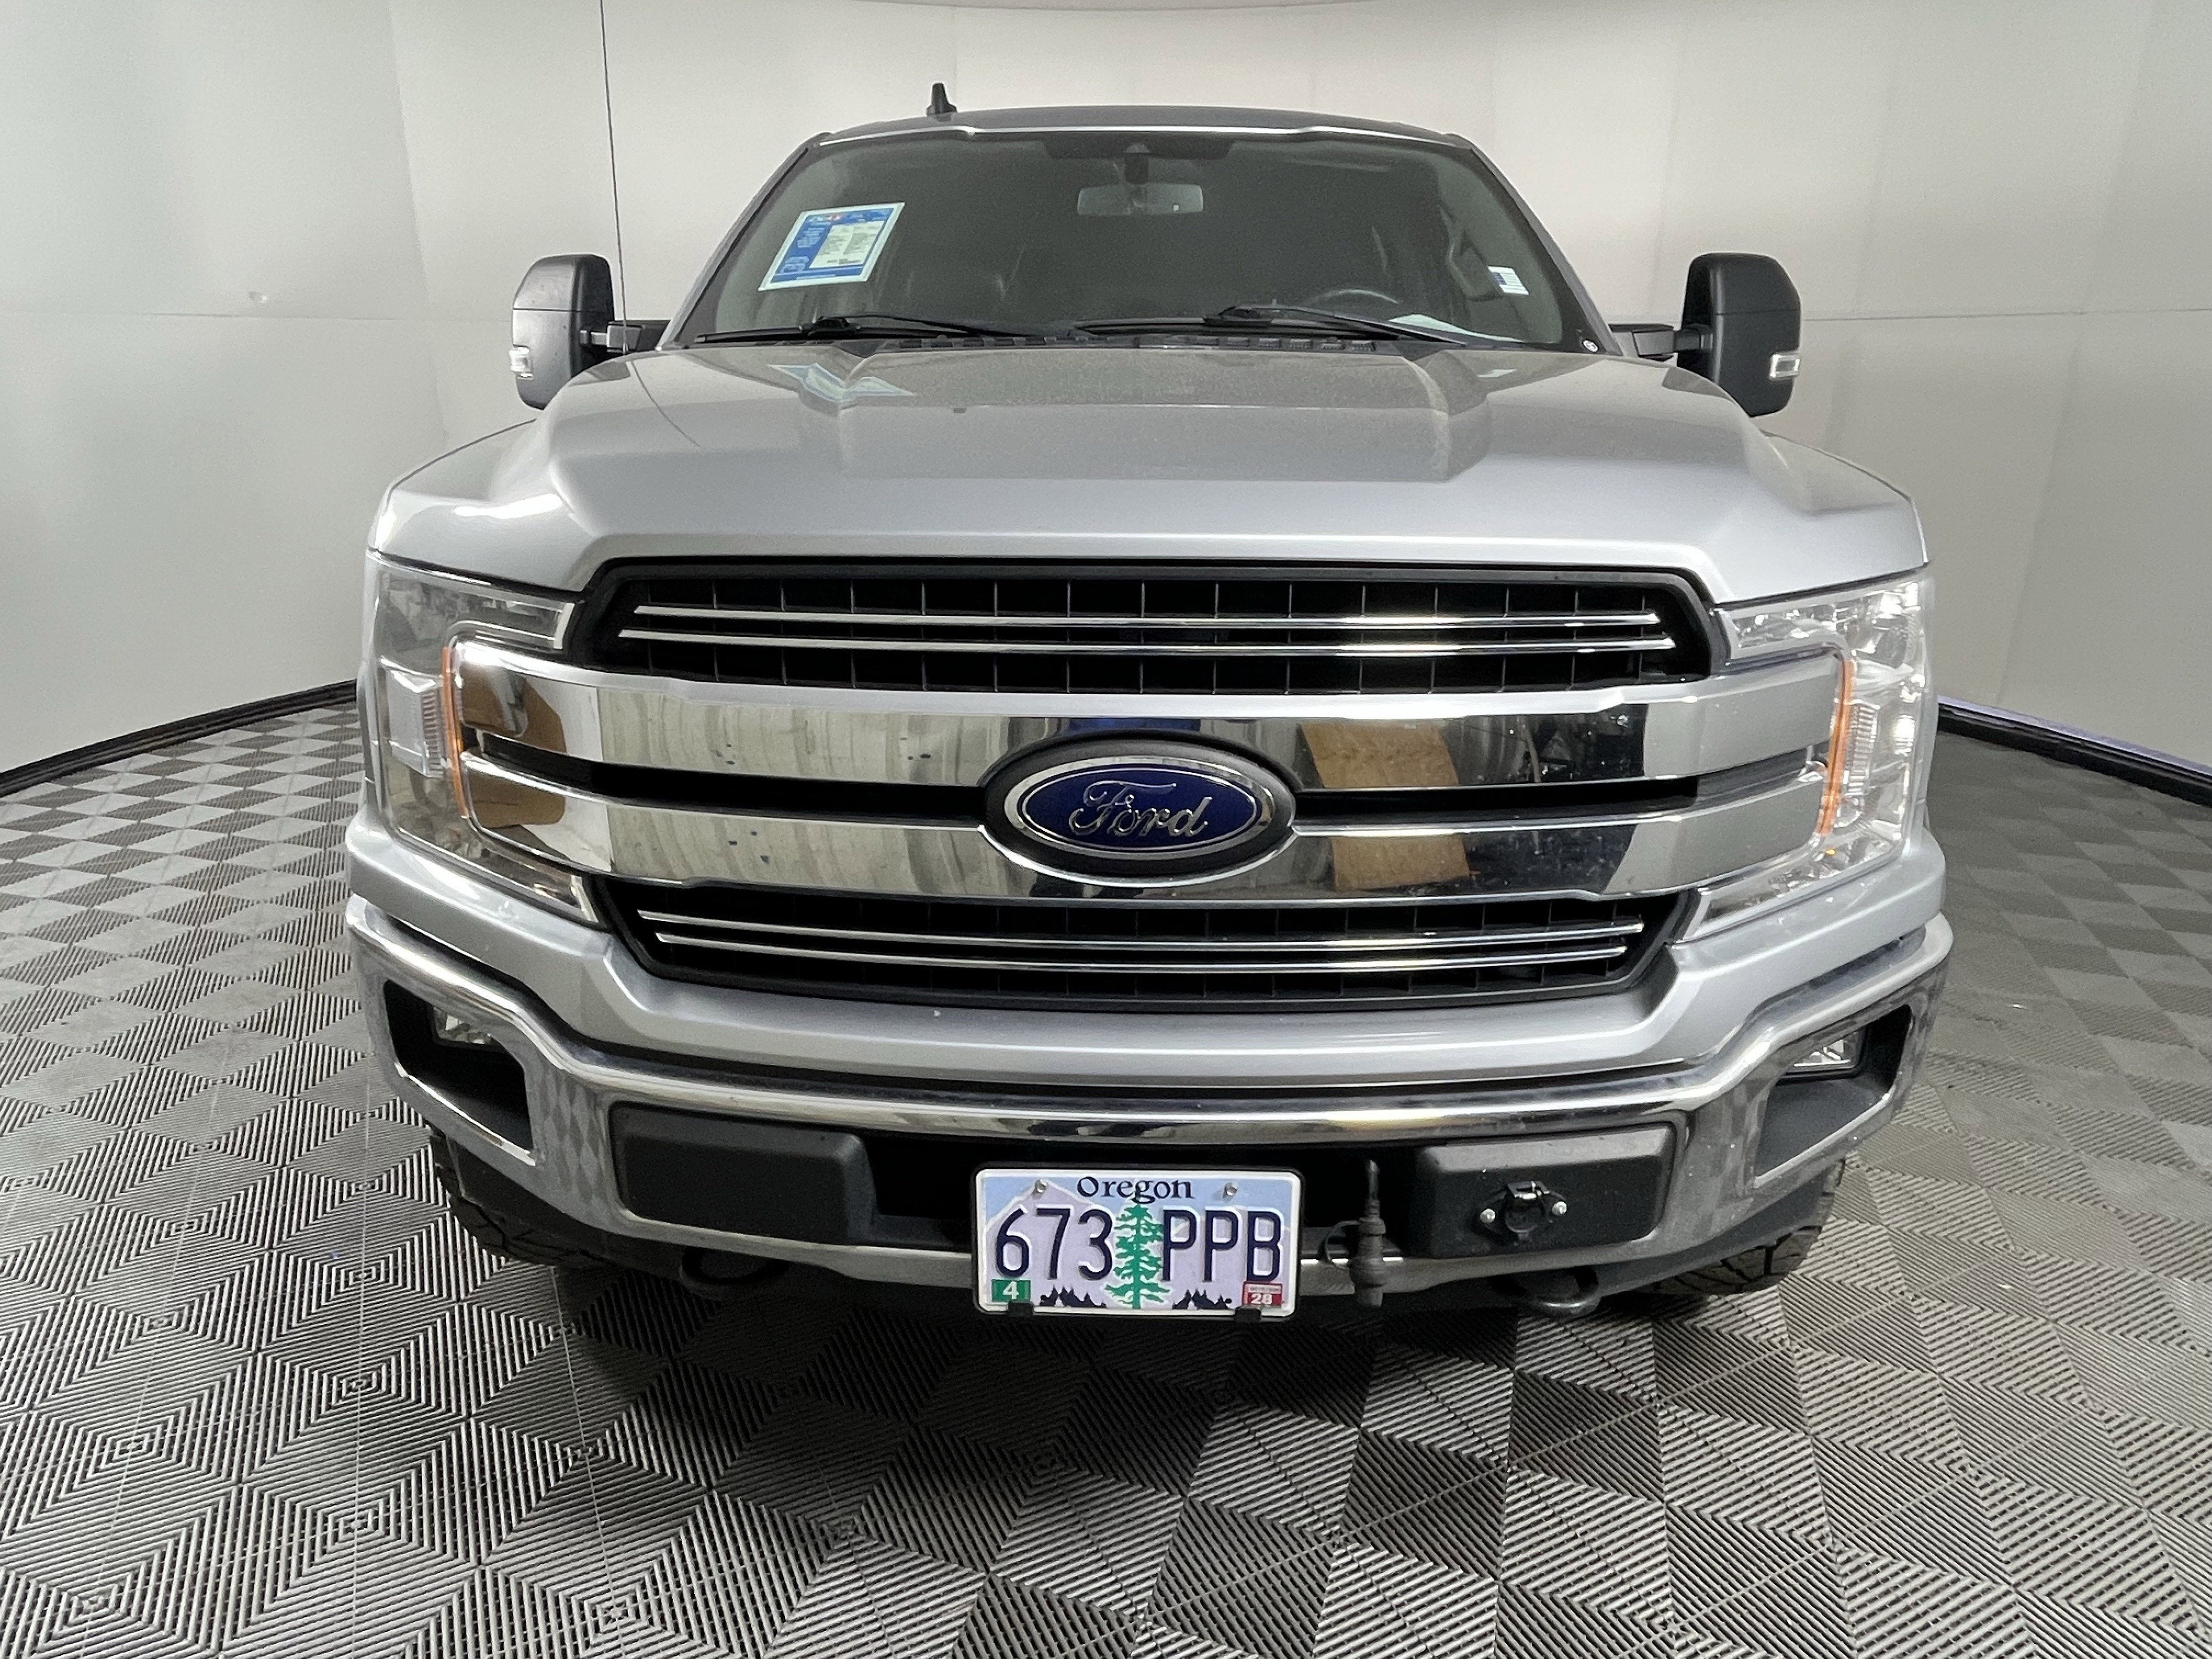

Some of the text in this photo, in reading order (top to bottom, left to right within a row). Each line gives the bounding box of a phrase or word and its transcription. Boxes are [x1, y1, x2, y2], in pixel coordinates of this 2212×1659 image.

[1069, 780, 1213, 837] Ford
[1076, 1176, 1194, 1204] Oregon
[995, 1207, 1281, 1283] 673 PPB
[1002, 1282, 1019, 1300] 4
[1251, 1294, 1273, 1305] 28
